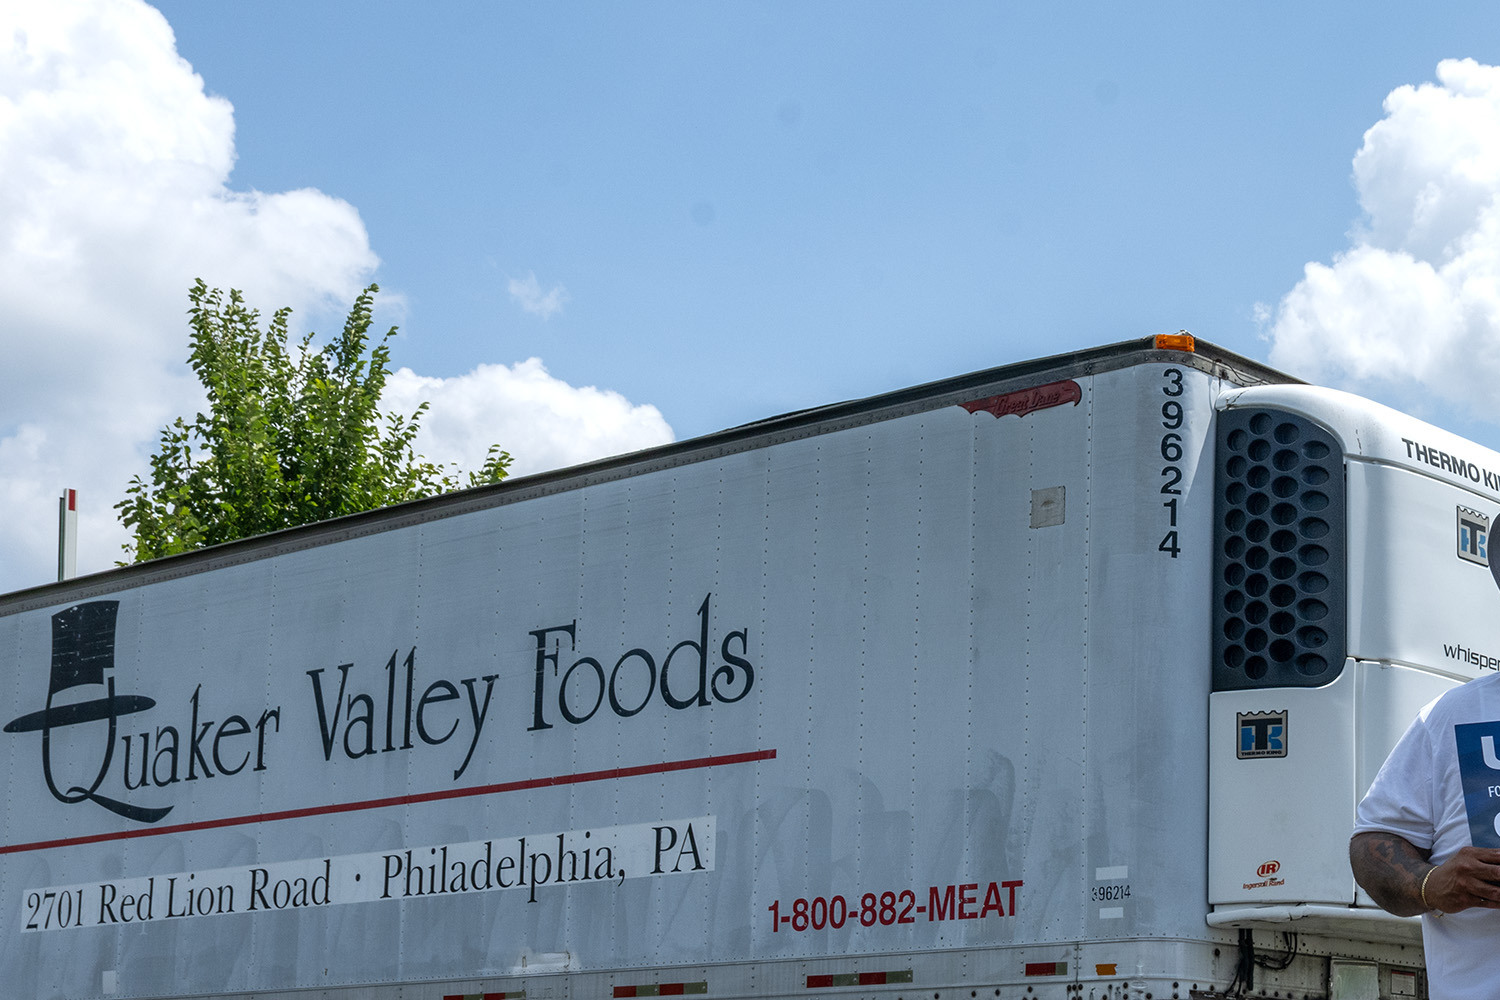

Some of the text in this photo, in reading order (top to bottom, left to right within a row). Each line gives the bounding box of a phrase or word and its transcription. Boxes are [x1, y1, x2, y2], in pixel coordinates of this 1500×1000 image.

[1158, 368, 1184, 559] 396214
[1401, 438, 1480, 483] THERMO
[42, 592, 756, 823] Quaker Valley Foods
[26, 822, 706, 929] 2701 Red Lion Road Philadelphia, PA
[768, 880, 1024, 933] 1-800-882-MEAT
